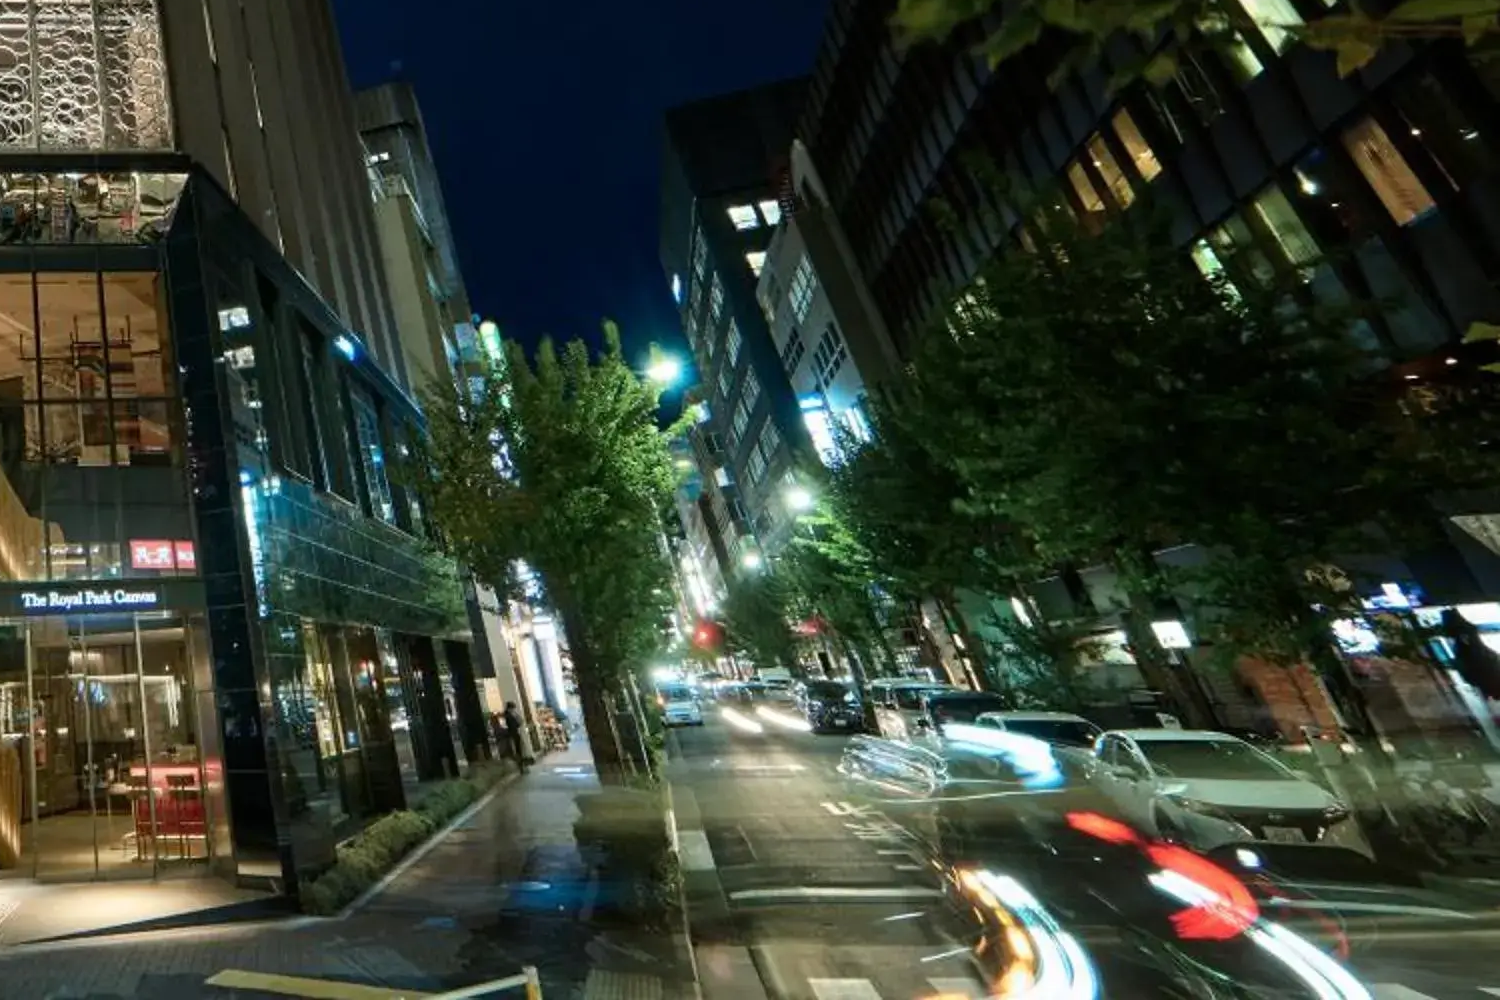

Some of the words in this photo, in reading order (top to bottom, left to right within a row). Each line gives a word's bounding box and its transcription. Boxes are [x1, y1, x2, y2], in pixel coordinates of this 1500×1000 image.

[21, 592, 47, 608] The
[48, 590, 83, 610] Royal
[85, 589, 112, 605] Park
[113, 588, 157, 604] Canvas
